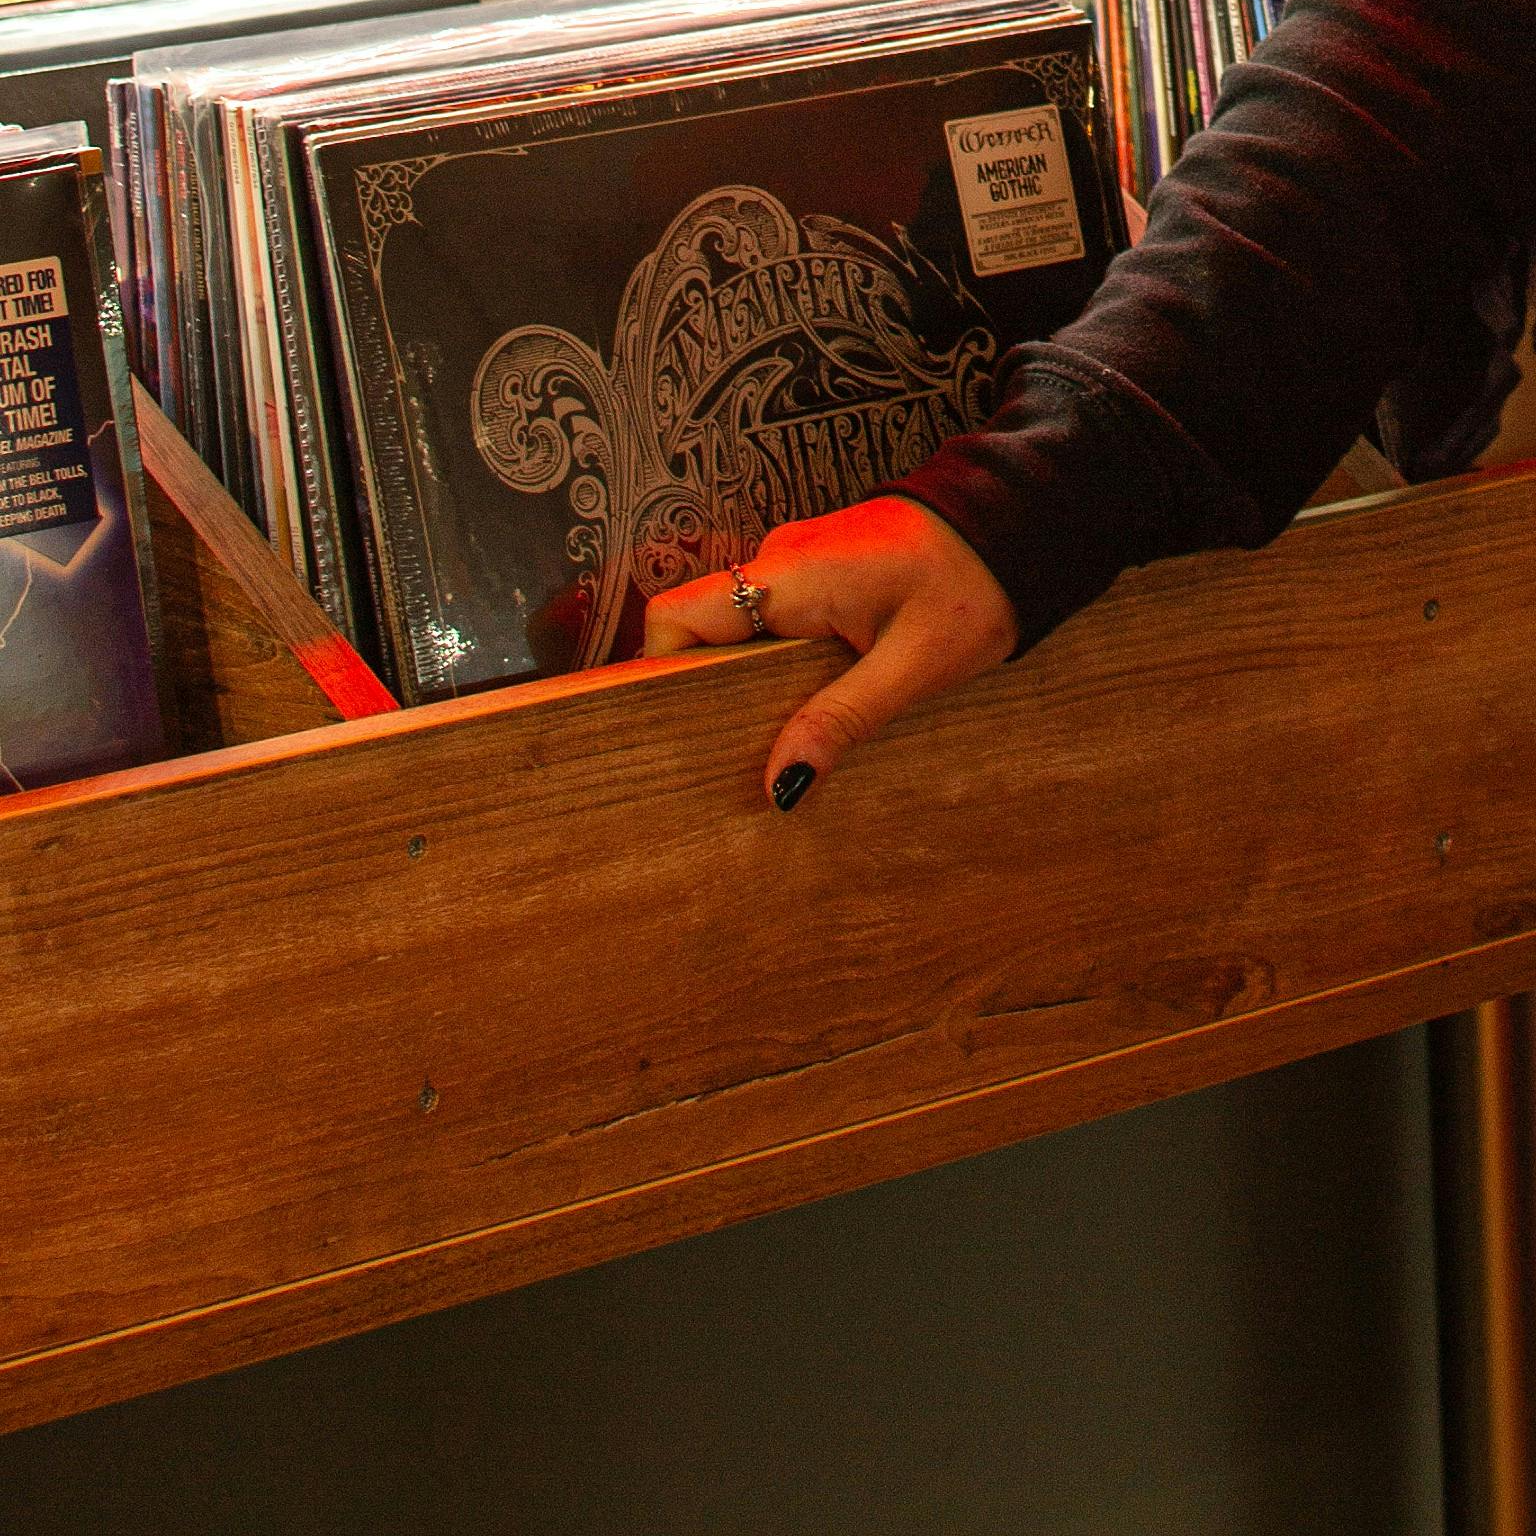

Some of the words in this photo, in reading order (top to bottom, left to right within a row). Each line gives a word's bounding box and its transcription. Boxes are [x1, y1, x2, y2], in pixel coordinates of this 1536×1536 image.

[976, 153, 1050, 184] AMERICAN
[989, 174, 1043, 203] GOTHIC
[27, 267, 57, 292] FOR
[12, 291, 55, 318] TIME!
[31, 375, 57, 403] OF
[4, 401, 58, 434] TIME!
[15, 427, 74, 452] MAGAZINE
[9, 474, 29, 491] THE
[28, 470, 55, 487] BELL
[12, 492, 26, 508] TO
[34, 502, 68, 521] DEATH
